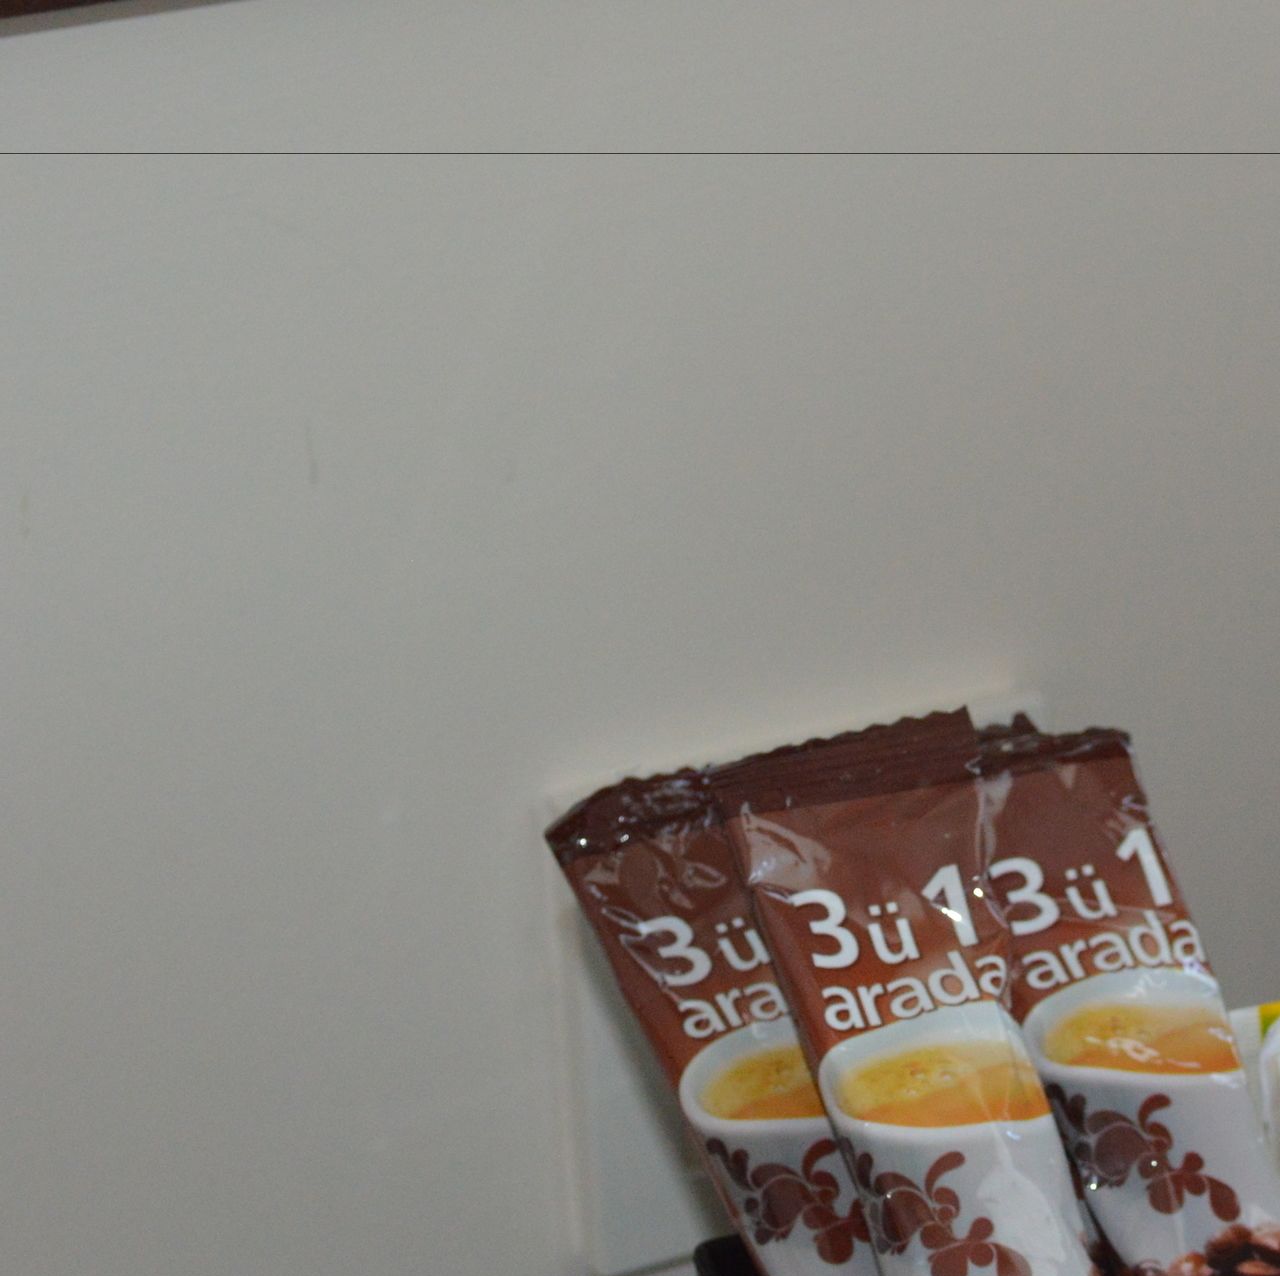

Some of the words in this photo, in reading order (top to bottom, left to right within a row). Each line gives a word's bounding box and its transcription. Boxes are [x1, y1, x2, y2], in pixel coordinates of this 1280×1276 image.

[786, 889, 859, 969] 3
[868, 902, 920, 965] ü
[921, 864, 979, 948] 1
[989, 857, 1061, 936] 3
[1065, 864, 1118, 920] ü
[1116, 826, 1174, 906] 1
[638, 915, 713, 986] 3
[714, 917, 770, 971] ü
[1021, 910, 1207, 990] arada
[821, 951, 1007, 1031] arada
